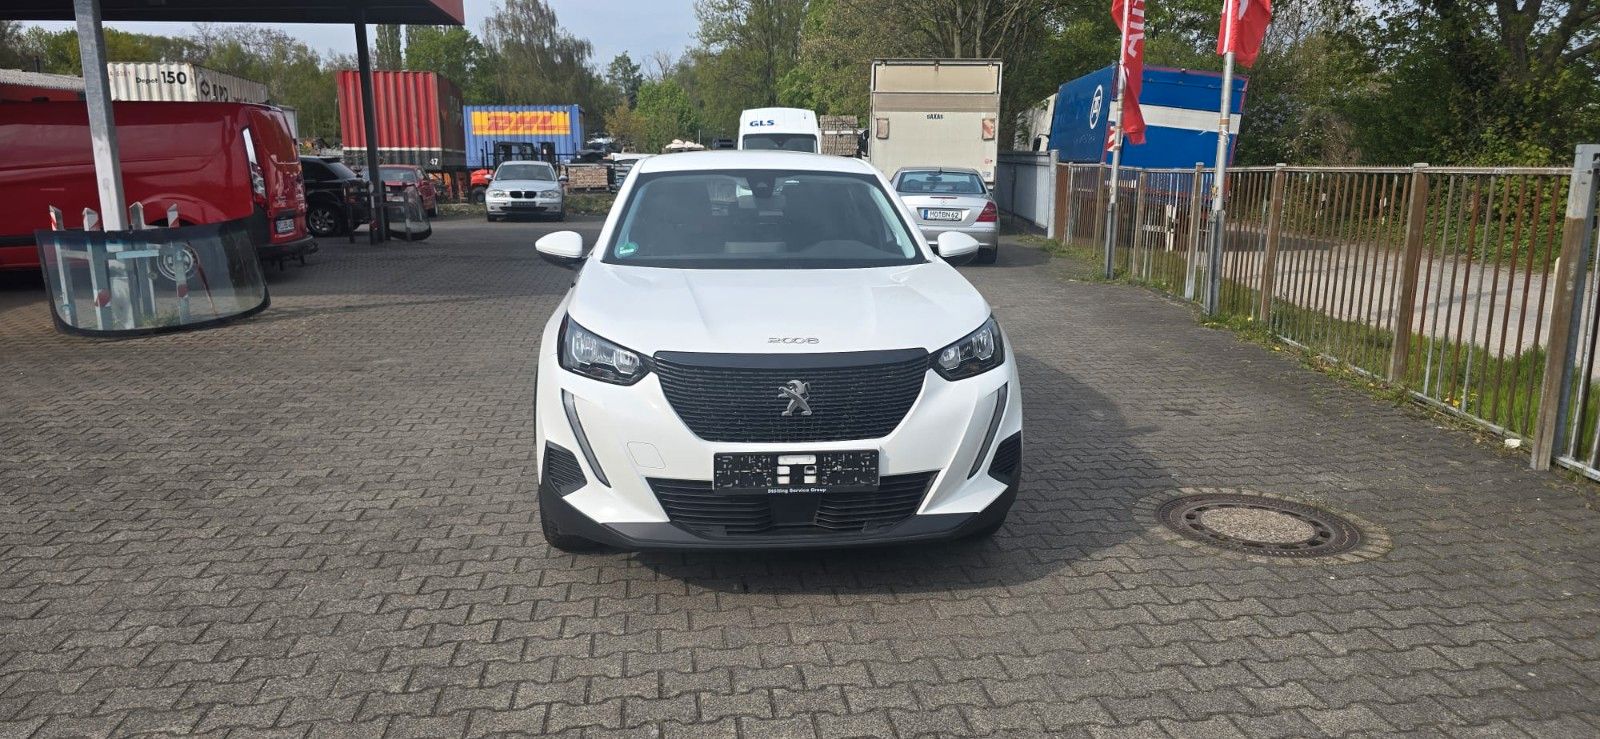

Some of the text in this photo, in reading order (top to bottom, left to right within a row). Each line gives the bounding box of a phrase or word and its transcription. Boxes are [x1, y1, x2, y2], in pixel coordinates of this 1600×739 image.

[161, 71, 187, 85] 150
[487, 115, 557, 131] DHL
[749, 119, 775, 127] GLS
[767, 337, 820, 345] 2008
